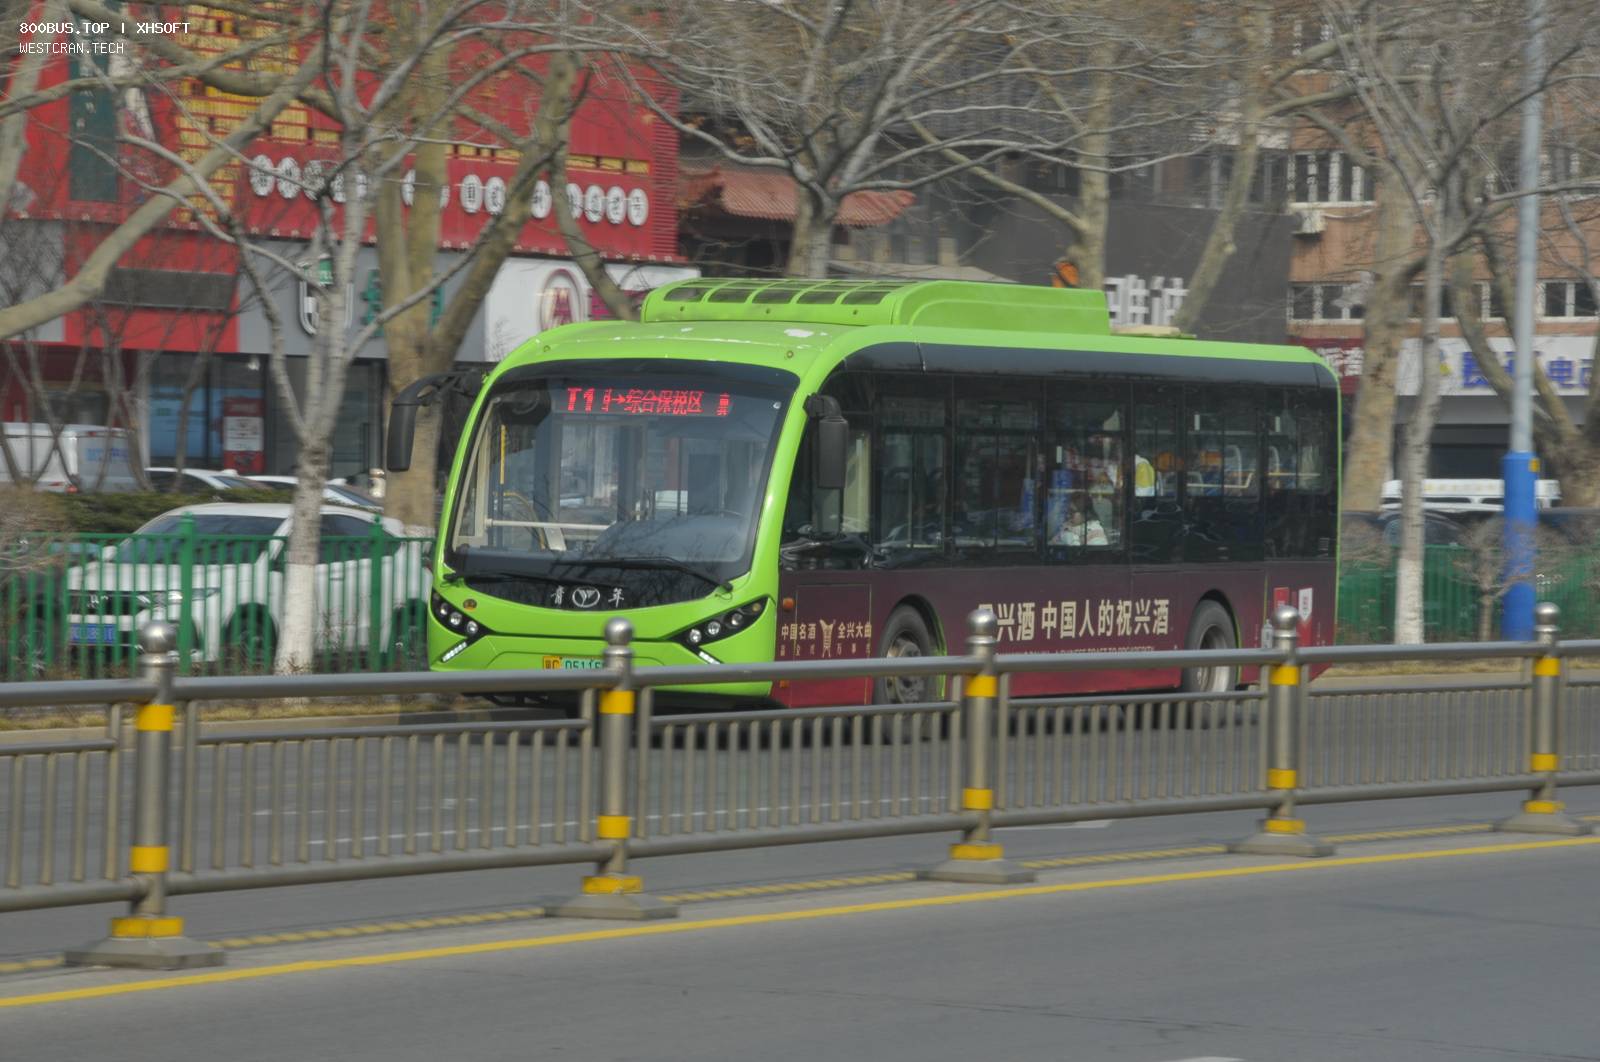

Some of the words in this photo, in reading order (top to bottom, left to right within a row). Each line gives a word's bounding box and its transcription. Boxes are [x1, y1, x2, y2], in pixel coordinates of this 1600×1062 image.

[566, 387, 596, 412] T1
[977, 601, 1036, 642] 兴酒
[1041, 598, 1170, 640] 中国人的祝兴酒
